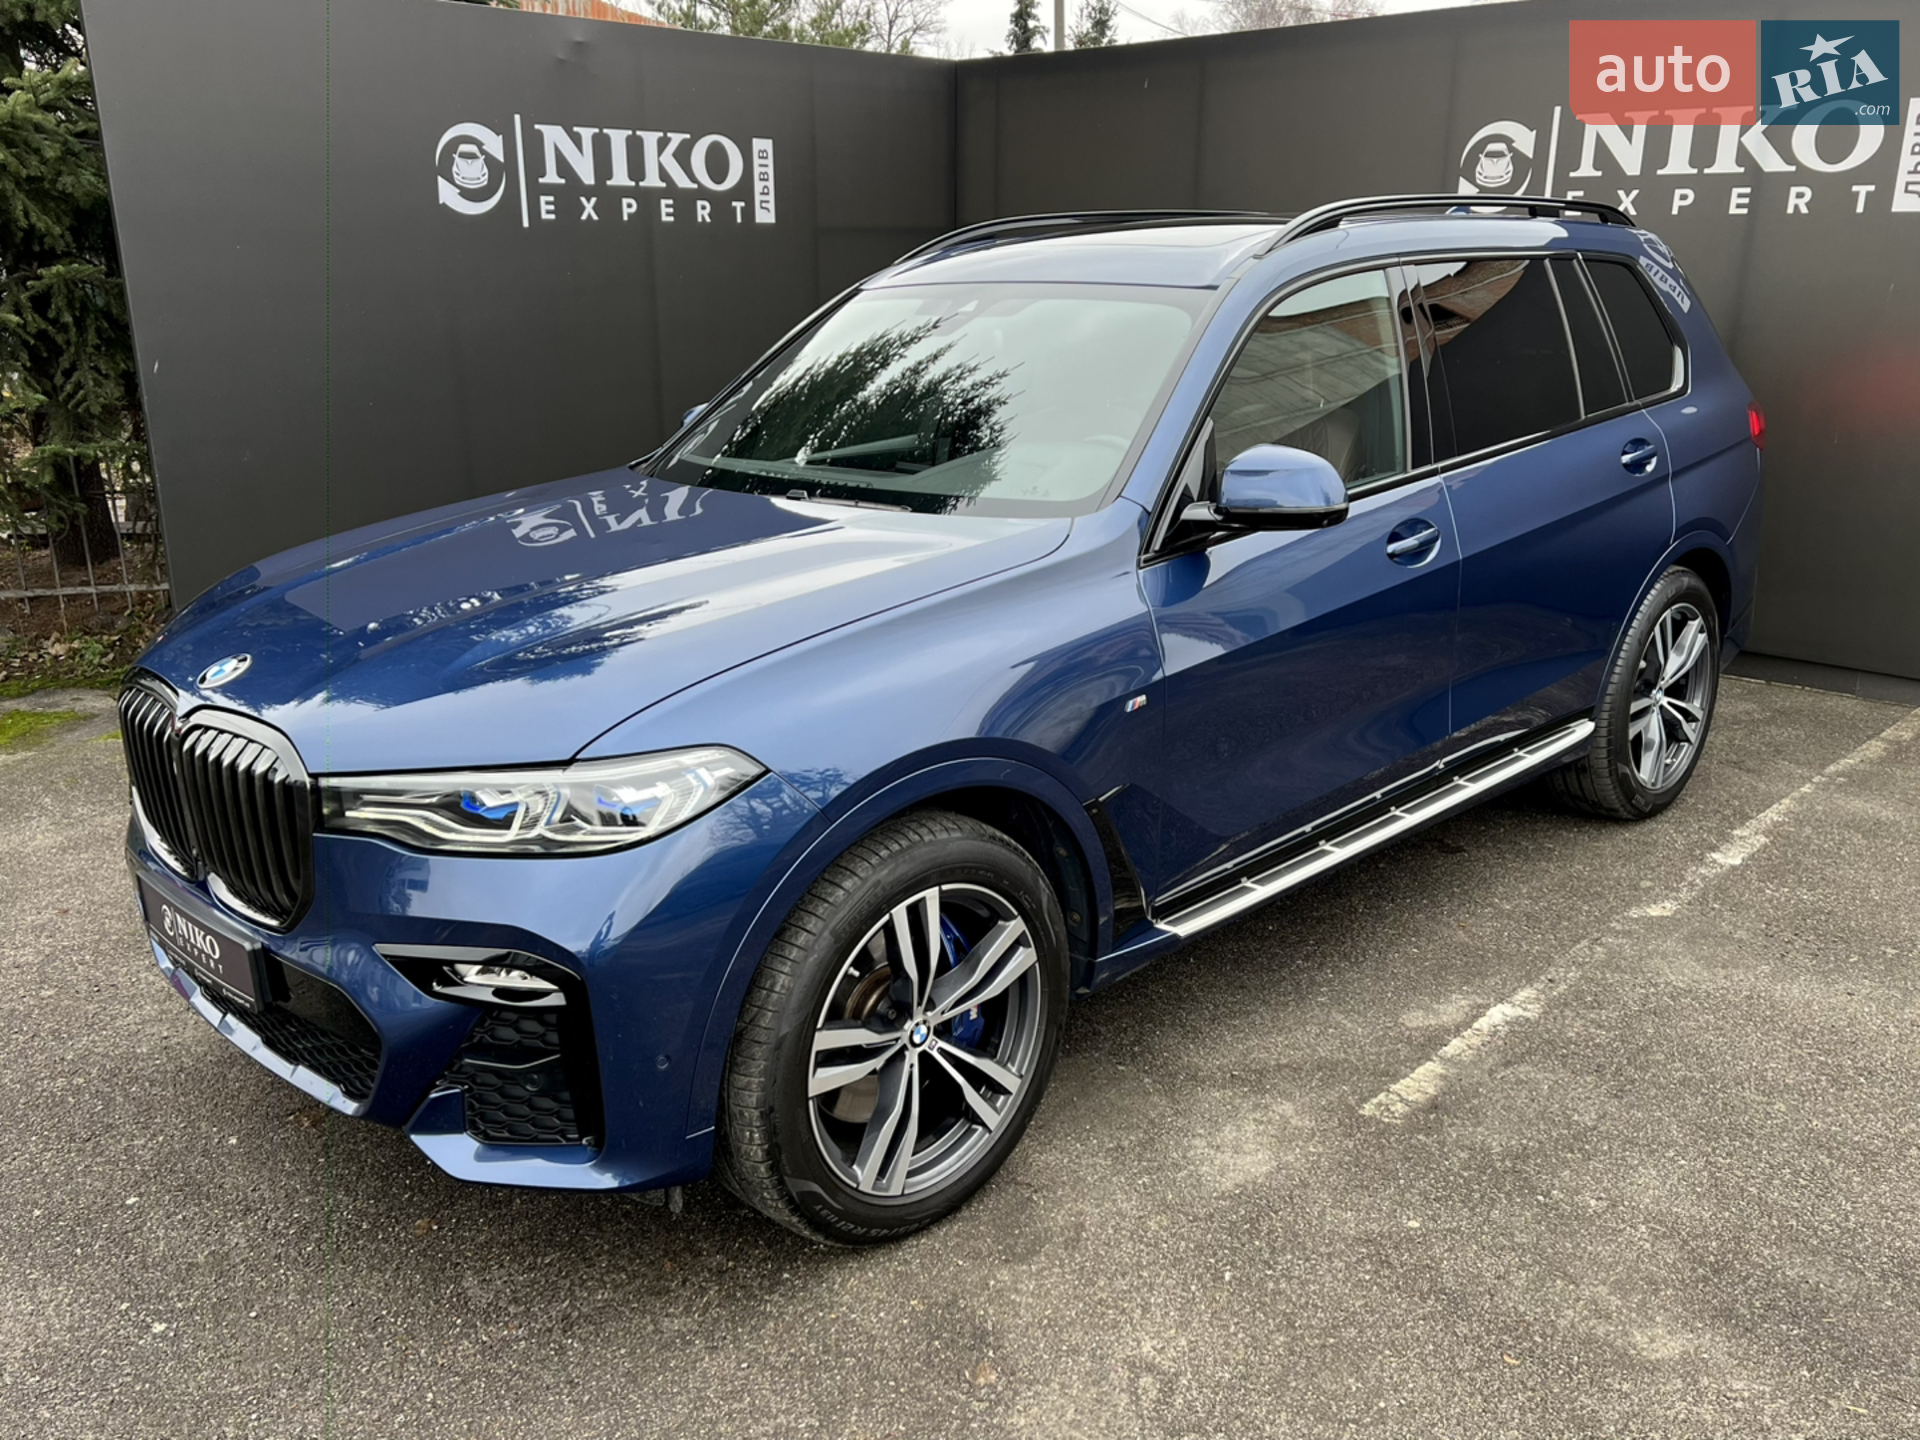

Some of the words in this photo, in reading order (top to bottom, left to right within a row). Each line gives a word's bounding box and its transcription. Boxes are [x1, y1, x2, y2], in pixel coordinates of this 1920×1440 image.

[533, 124, 744, 191] NIKO
[1569, 100, 1885, 177] NIKO
[539, 195, 745, 223] EXPERT
[757, 148, 772, 213] ЛЬВІВ
[176, 913, 220, 960] NIKO
